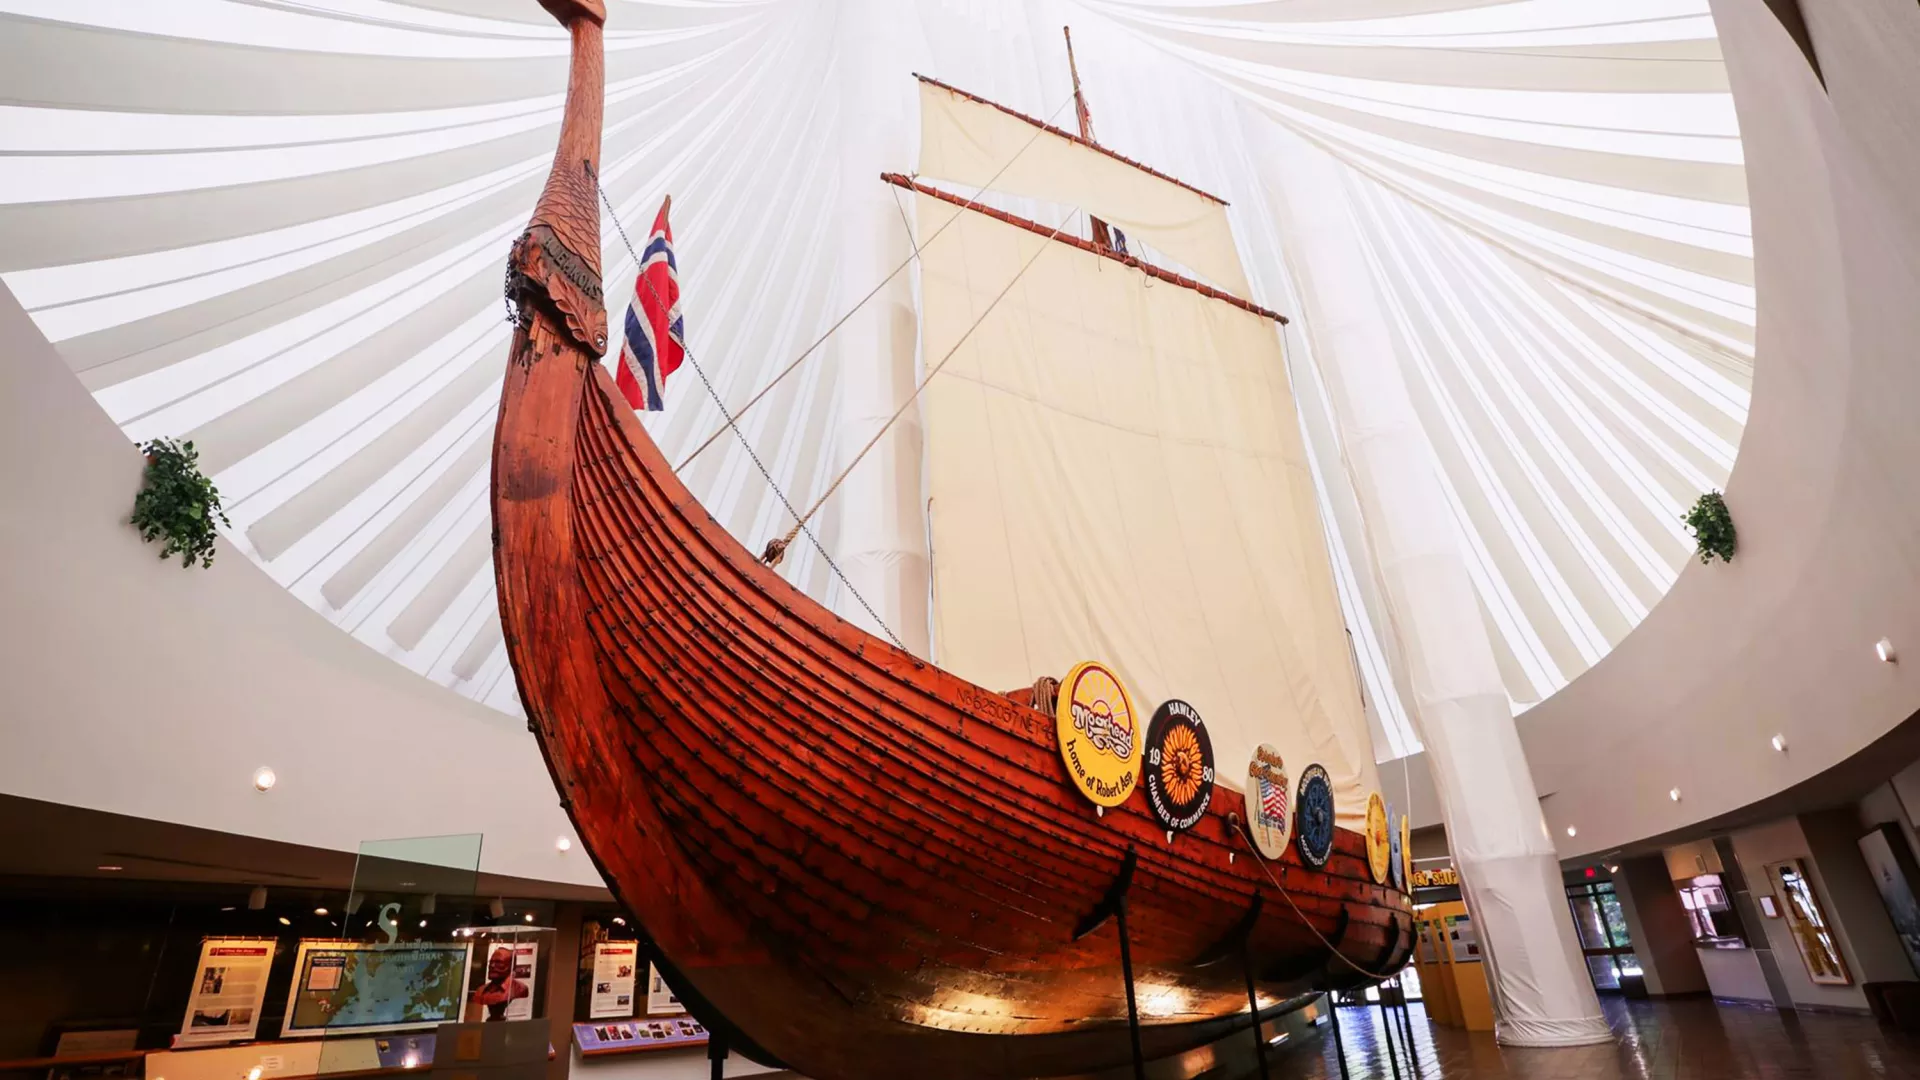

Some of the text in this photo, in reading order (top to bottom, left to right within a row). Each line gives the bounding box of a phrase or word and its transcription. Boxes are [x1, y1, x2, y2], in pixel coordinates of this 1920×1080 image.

[1020, 713, 1041, 735] NET
[1168, 702, 1200, 727] HAWLEY
[1071, 704, 1134, 758] Moorhead
[1067, 738, 1085, 778] home
[1086, 776, 1095, 790] of
[1096, 779, 1121, 797] Robert
[1149, 747, 1160, 766] 19
[1202, 766, 1213, 783] 80
[1149, 774, 1210, 828] CHAMBER OF COMMERCE
